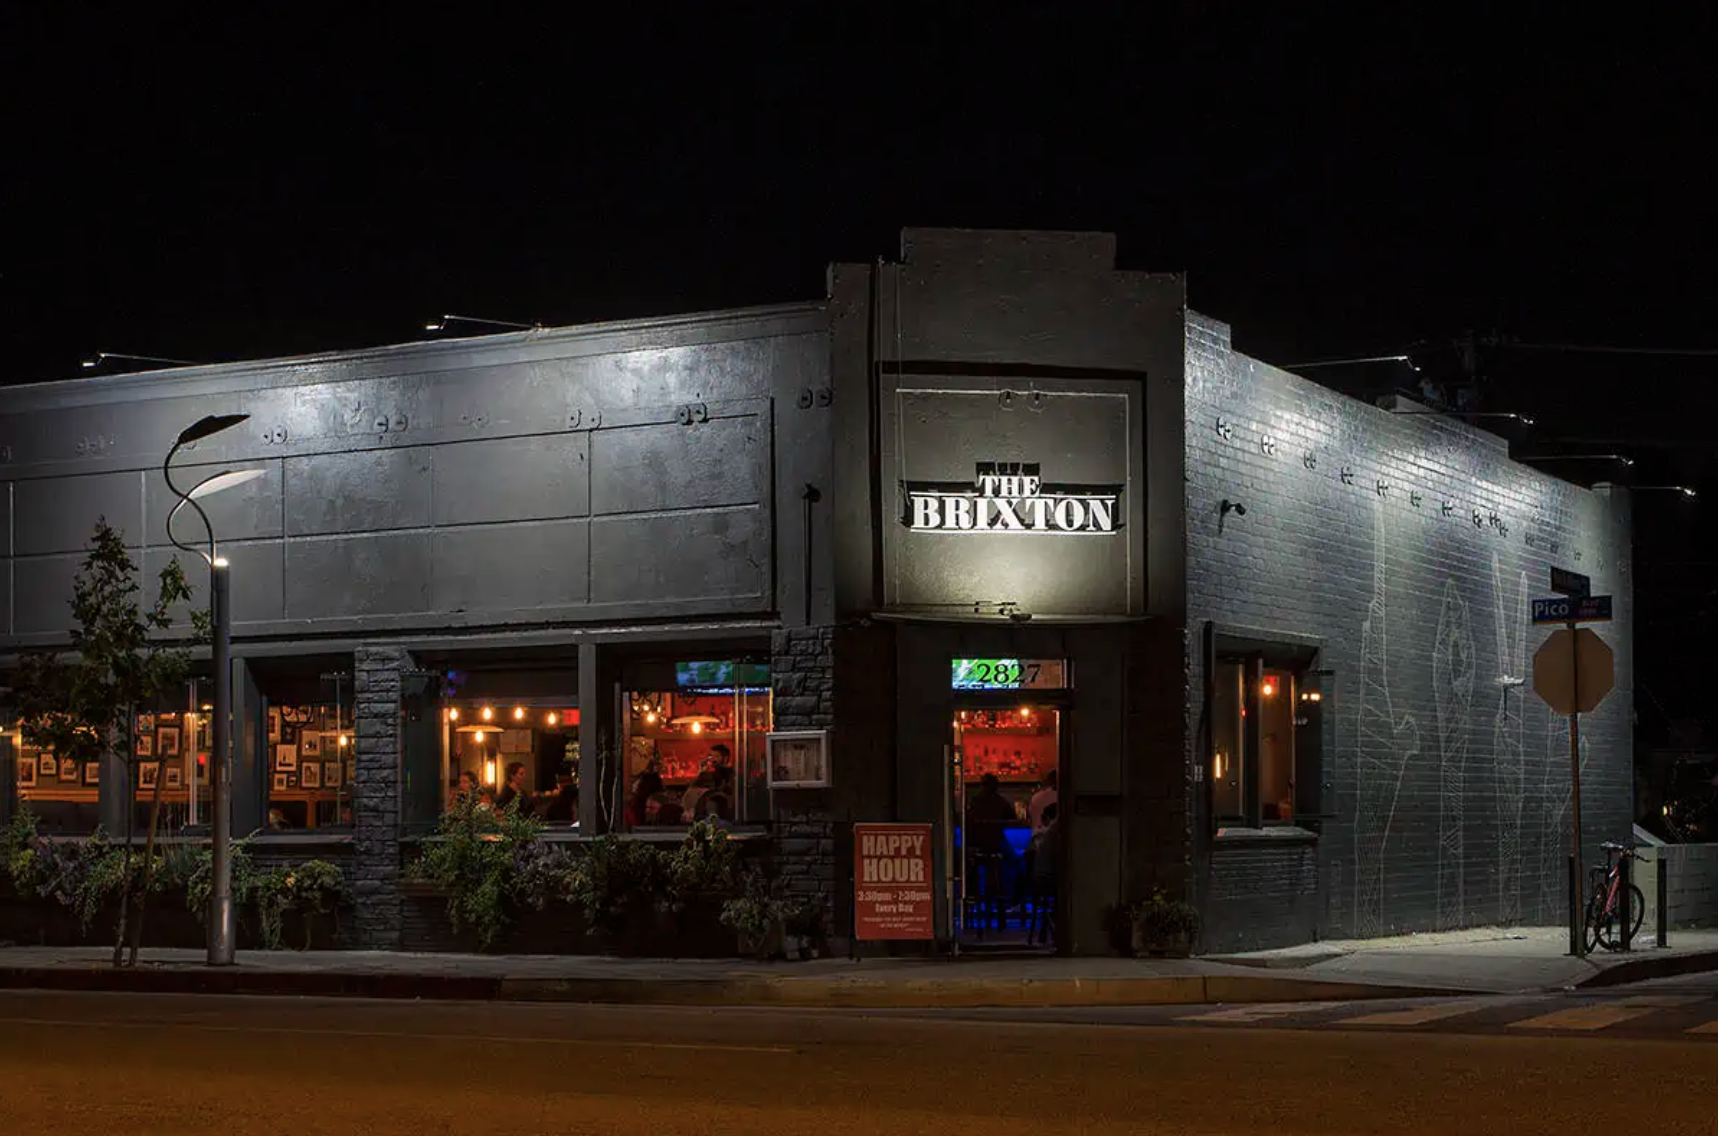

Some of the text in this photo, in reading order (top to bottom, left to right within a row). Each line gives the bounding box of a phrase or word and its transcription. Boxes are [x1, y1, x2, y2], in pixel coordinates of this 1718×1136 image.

[978, 475, 1041, 498] THE
[911, 496, 1116, 531] BRIXTON
[1534, 601, 1570, 618] Pico
[976, 663, 1041, 684] 2827
[862, 835, 925, 856] HAPPY
[862, 858, 925, 882] HOUR
